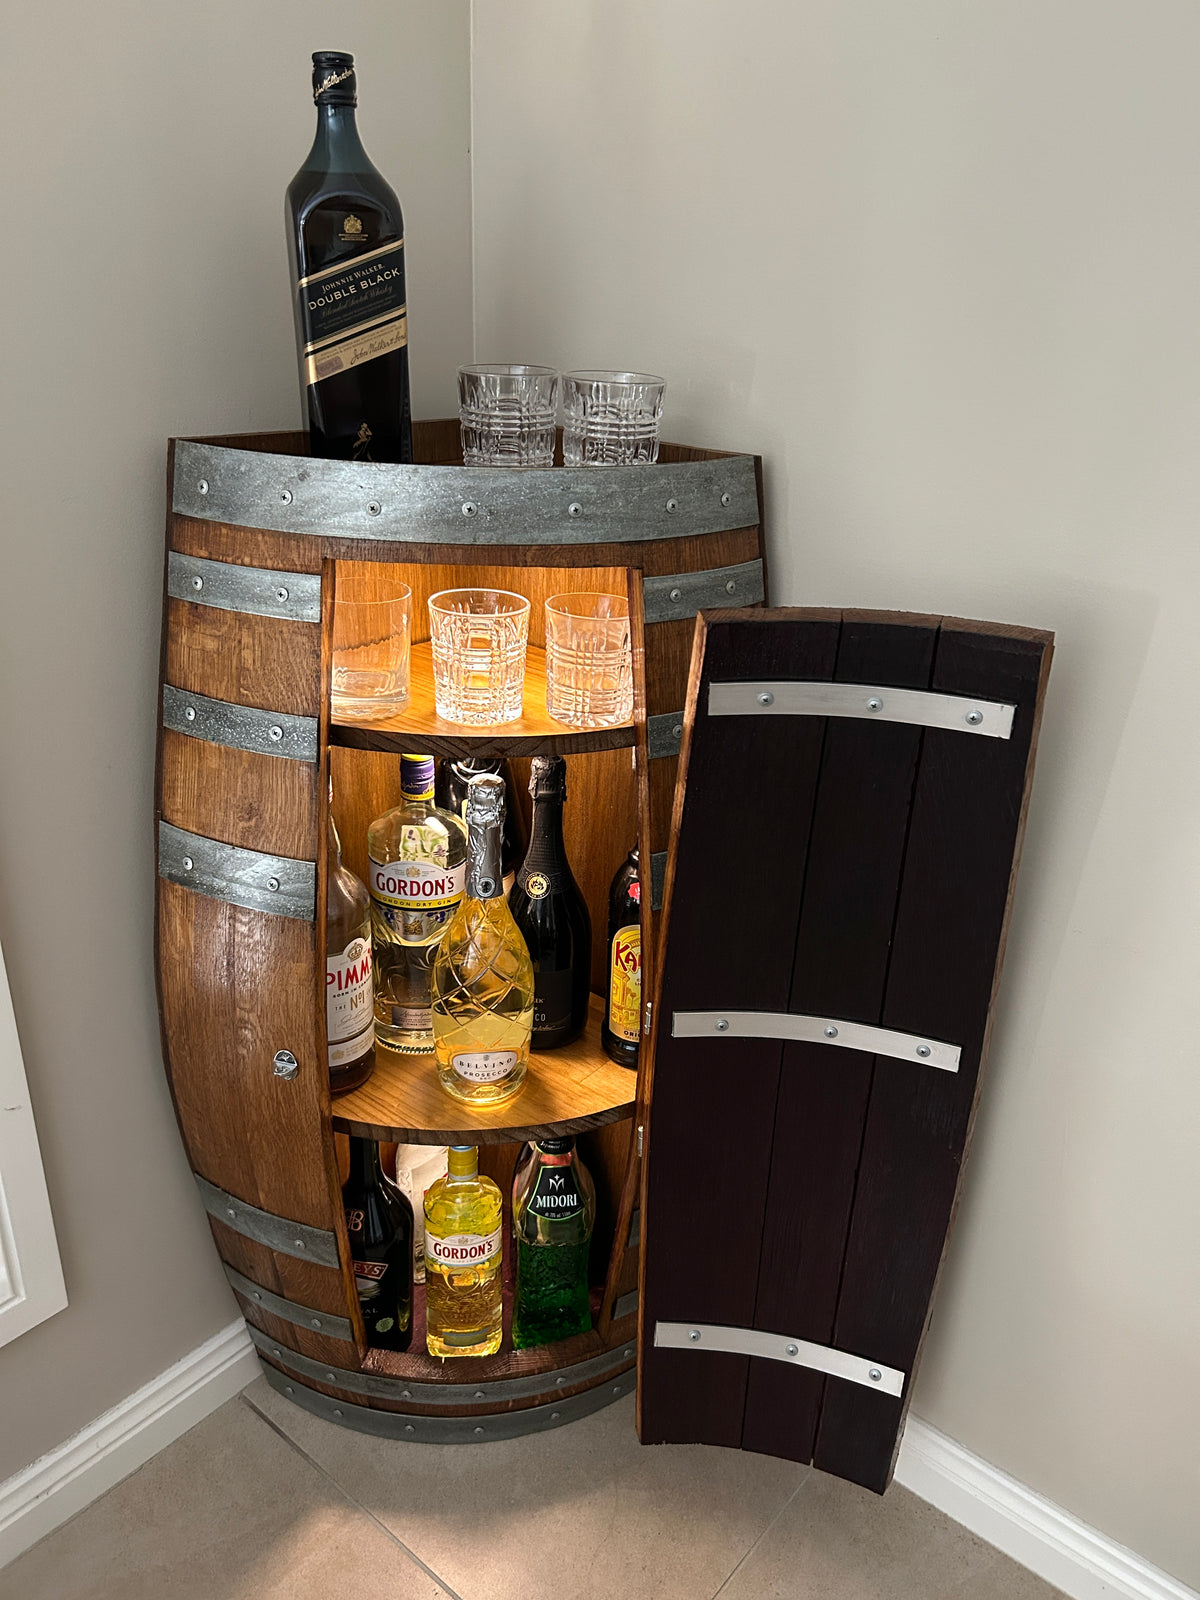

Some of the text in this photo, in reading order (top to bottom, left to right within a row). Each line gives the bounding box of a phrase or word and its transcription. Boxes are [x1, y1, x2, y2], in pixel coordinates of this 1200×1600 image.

[308, 267, 400, 310] DOUBLE BLACK
[321, 263, 383, 294] JOHNNIE WALKER
[376, 872, 454, 897] GORDON'S
[459, 1057, 512, 1069] BELVINO
[464, 1068, 508, 1078] PROSECCO
[536, 1193, 577, 1209] MIDORI
[434, 1240, 493, 1260] GORDON'S
